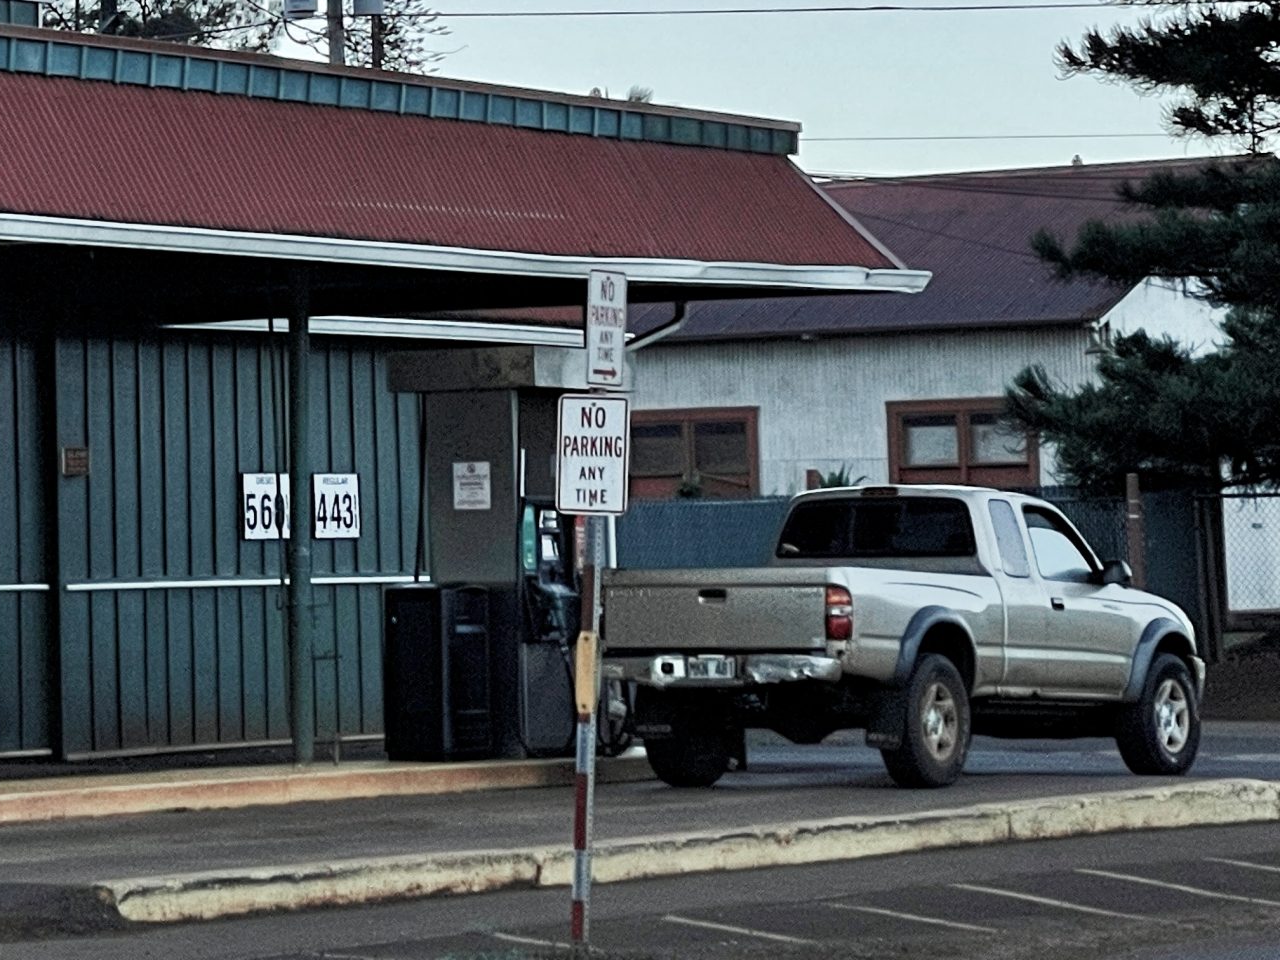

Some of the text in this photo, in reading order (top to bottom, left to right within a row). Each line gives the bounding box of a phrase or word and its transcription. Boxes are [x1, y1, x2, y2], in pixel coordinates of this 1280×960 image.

[601, 279, 615, 302] NO
[600, 330, 613, 344] ANY
[597, 347, 613, 362] TIME
[581, 406, 606, 428] NO
[563, 435, 623, 458] PARKING
[322, 476, 349, 486] REGULAR
[579, 466, 605, 481] ANY
[575, 488, 607, 504] TIME
[317, 493, 354, 530] 443
